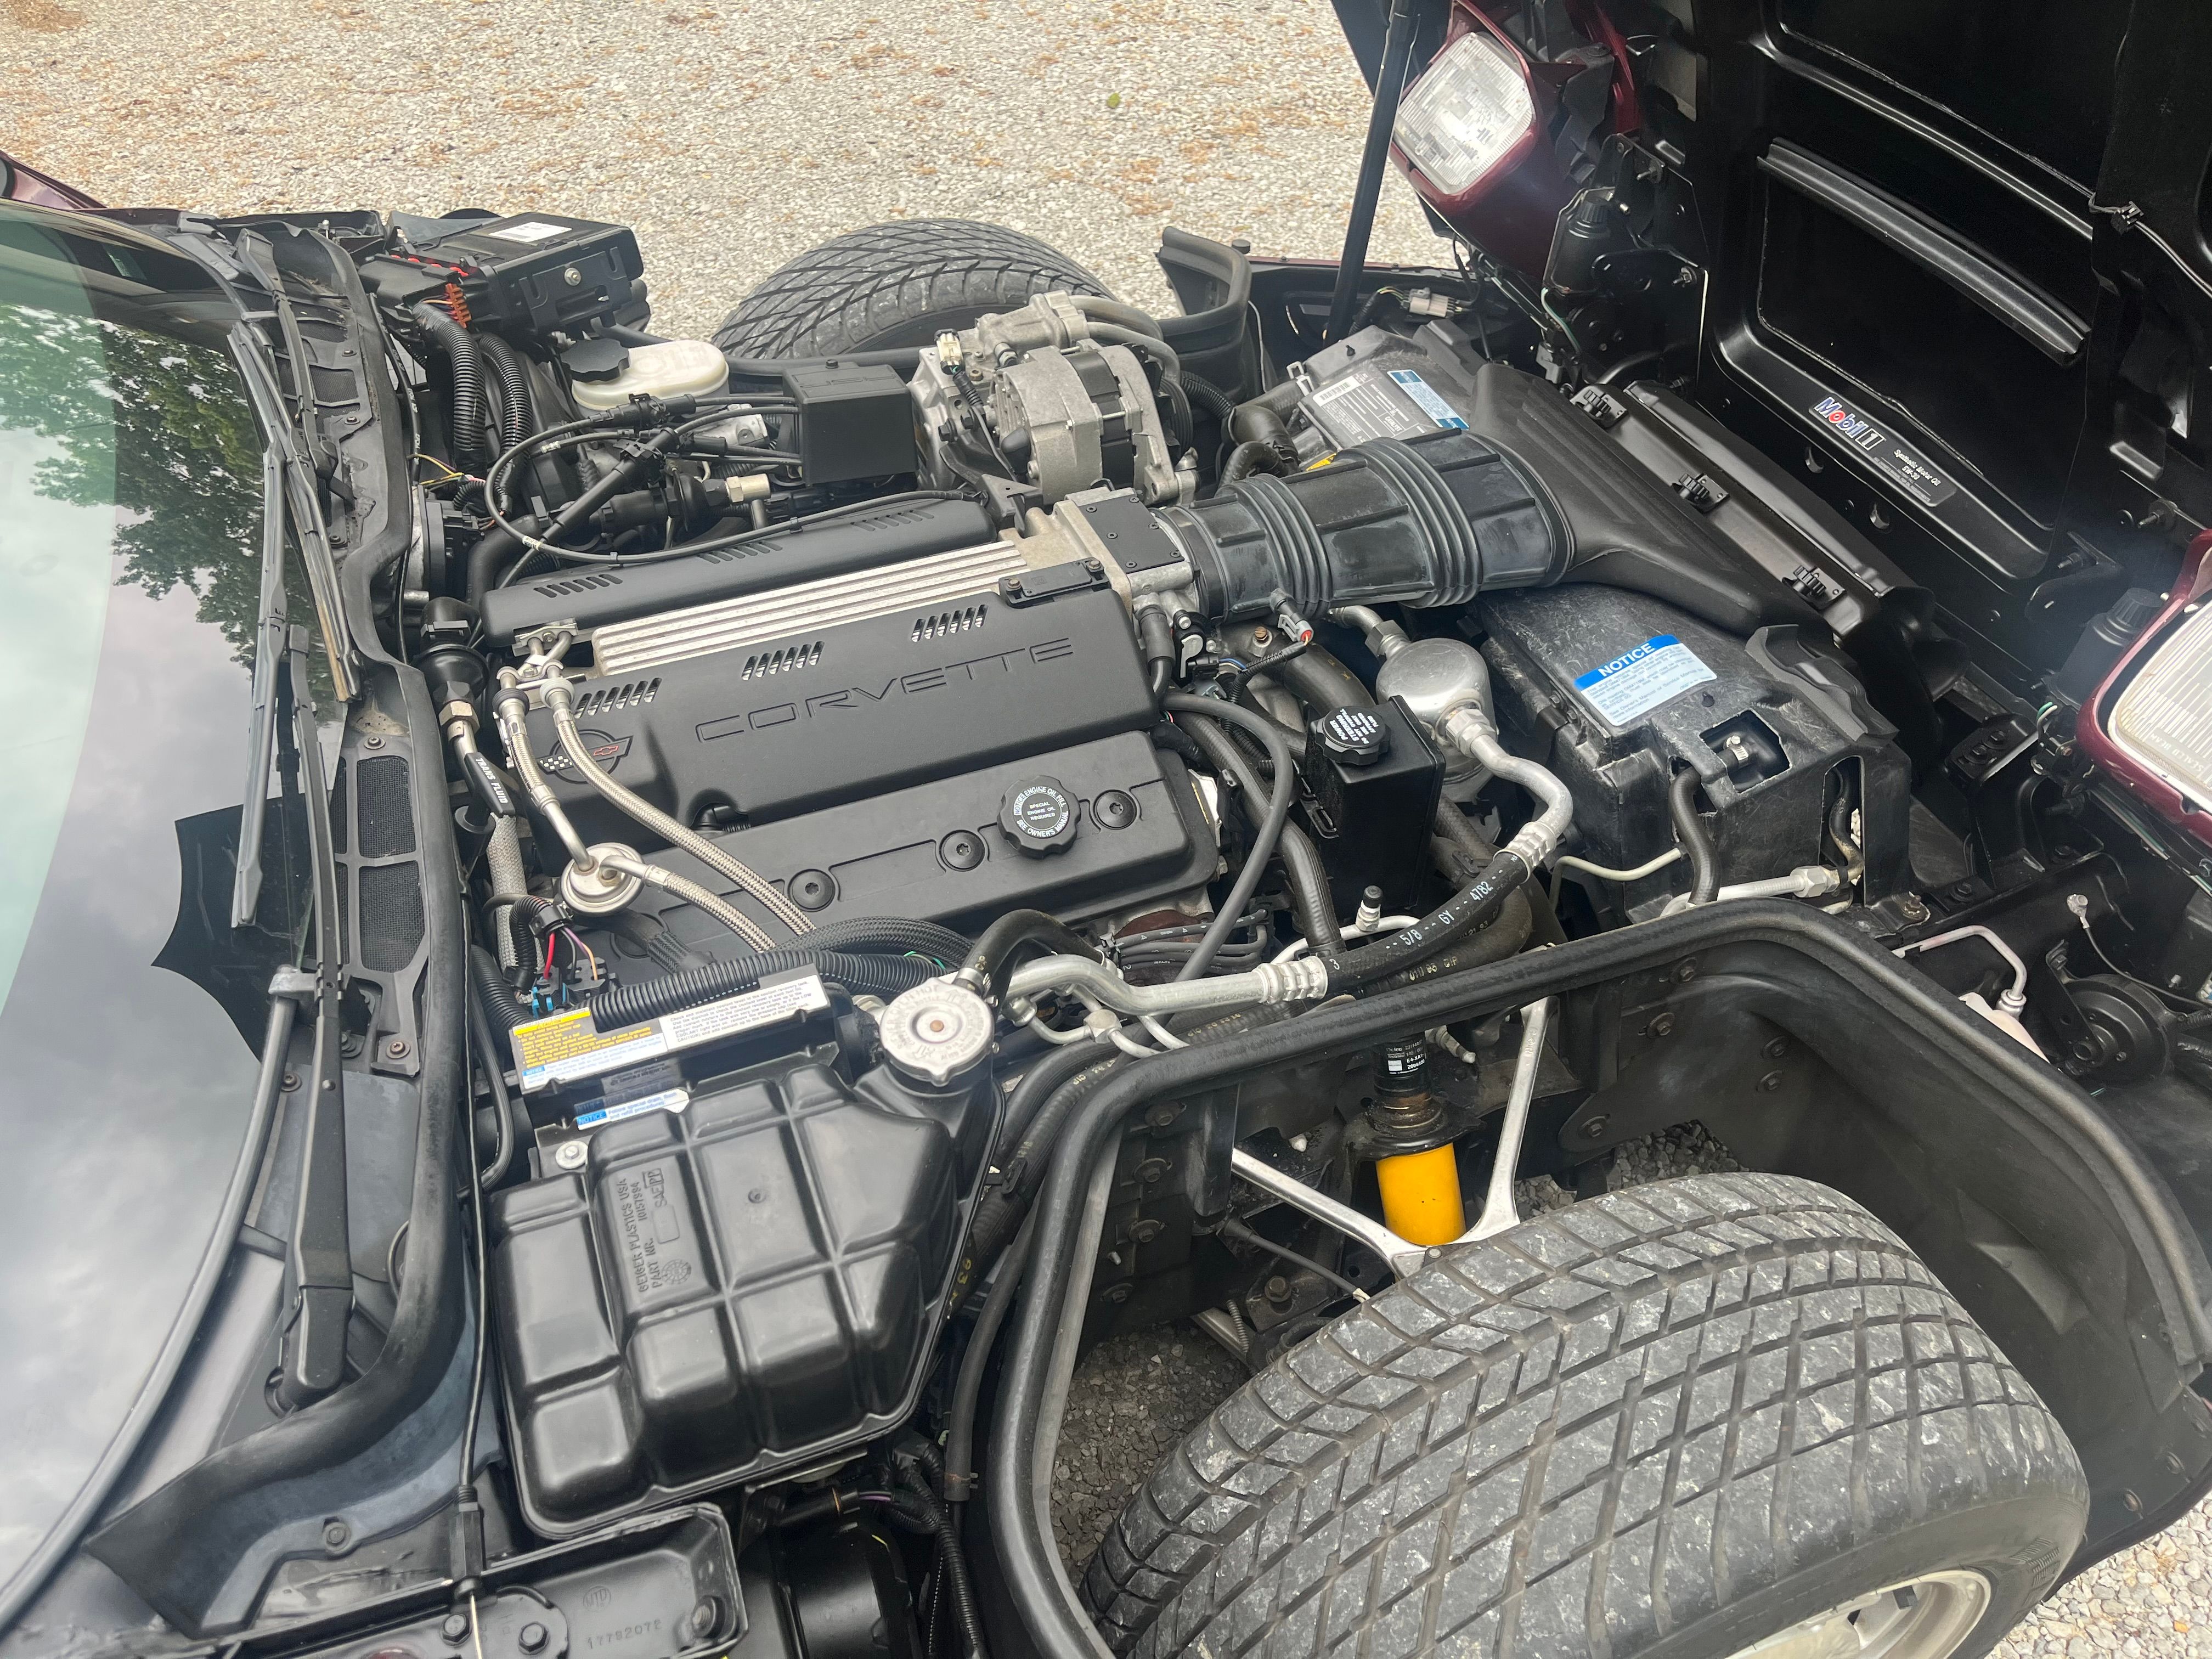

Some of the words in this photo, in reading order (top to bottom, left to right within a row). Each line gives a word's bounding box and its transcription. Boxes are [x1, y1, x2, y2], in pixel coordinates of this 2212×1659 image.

[1813, 396, 1869, 438] Mobil
[1893, 449, 1918, 469] Synthetic
[1915, 466, 1933, 481] Motor
[1929, 476, 1941, 487] Oil
[1901, 465, 1920, 481] 5W-30
[1598, 643, 1655, 677] NOTICE
[695, 636, 1074, 744] CORVETTE
[1329, 720, 1348, 740] POWER
[1335, 714, 1359, 741] STEERING
[1339, 708, 1356, 727] OVERFILL
[1350, 714, 1362, 725] ONLY
[1357, 712, 1376, 732] APPROVED
[1359, 725, 1369, 735] USE
[1353, 728, 1363, 737] NOT
[2149, 733, 2171, 751] BEAM
[2171, 748, 2204, 772] SEALED
[475, 757, 496, 780] TRANS
[490, 782, 509, 803] FLUID
[1015, 795, 1026, 815] NOTICE
[1025, 786, 1047, 797] ENGINE
[1047, 788, 1057, 798] OIL
[1056, 794, 1068, 808] FILL
[1017, 819, 1026, 831] SEE
[1027, 828, 1056, 838] OWNER'S
[1054, 810, 1069, 834] MANUAL
[1030, 812, 1056, 821] REQUIRED
[1398, 925, 1424, 949] 5/8
[1437, 907, 1456, 927] GY
[1467, 877, 1496, 904] 4782
[577, 1111, 606, 1125] NOTICE
[616, 1177, 630, 1200] USA
[650, 1183, 668, 1209] SAE
[619, 1201, 641, 1251] PLASTICS
[631, 1251, 650, 1293] GEIGER
[647, 1260, 663, 1288] PART
